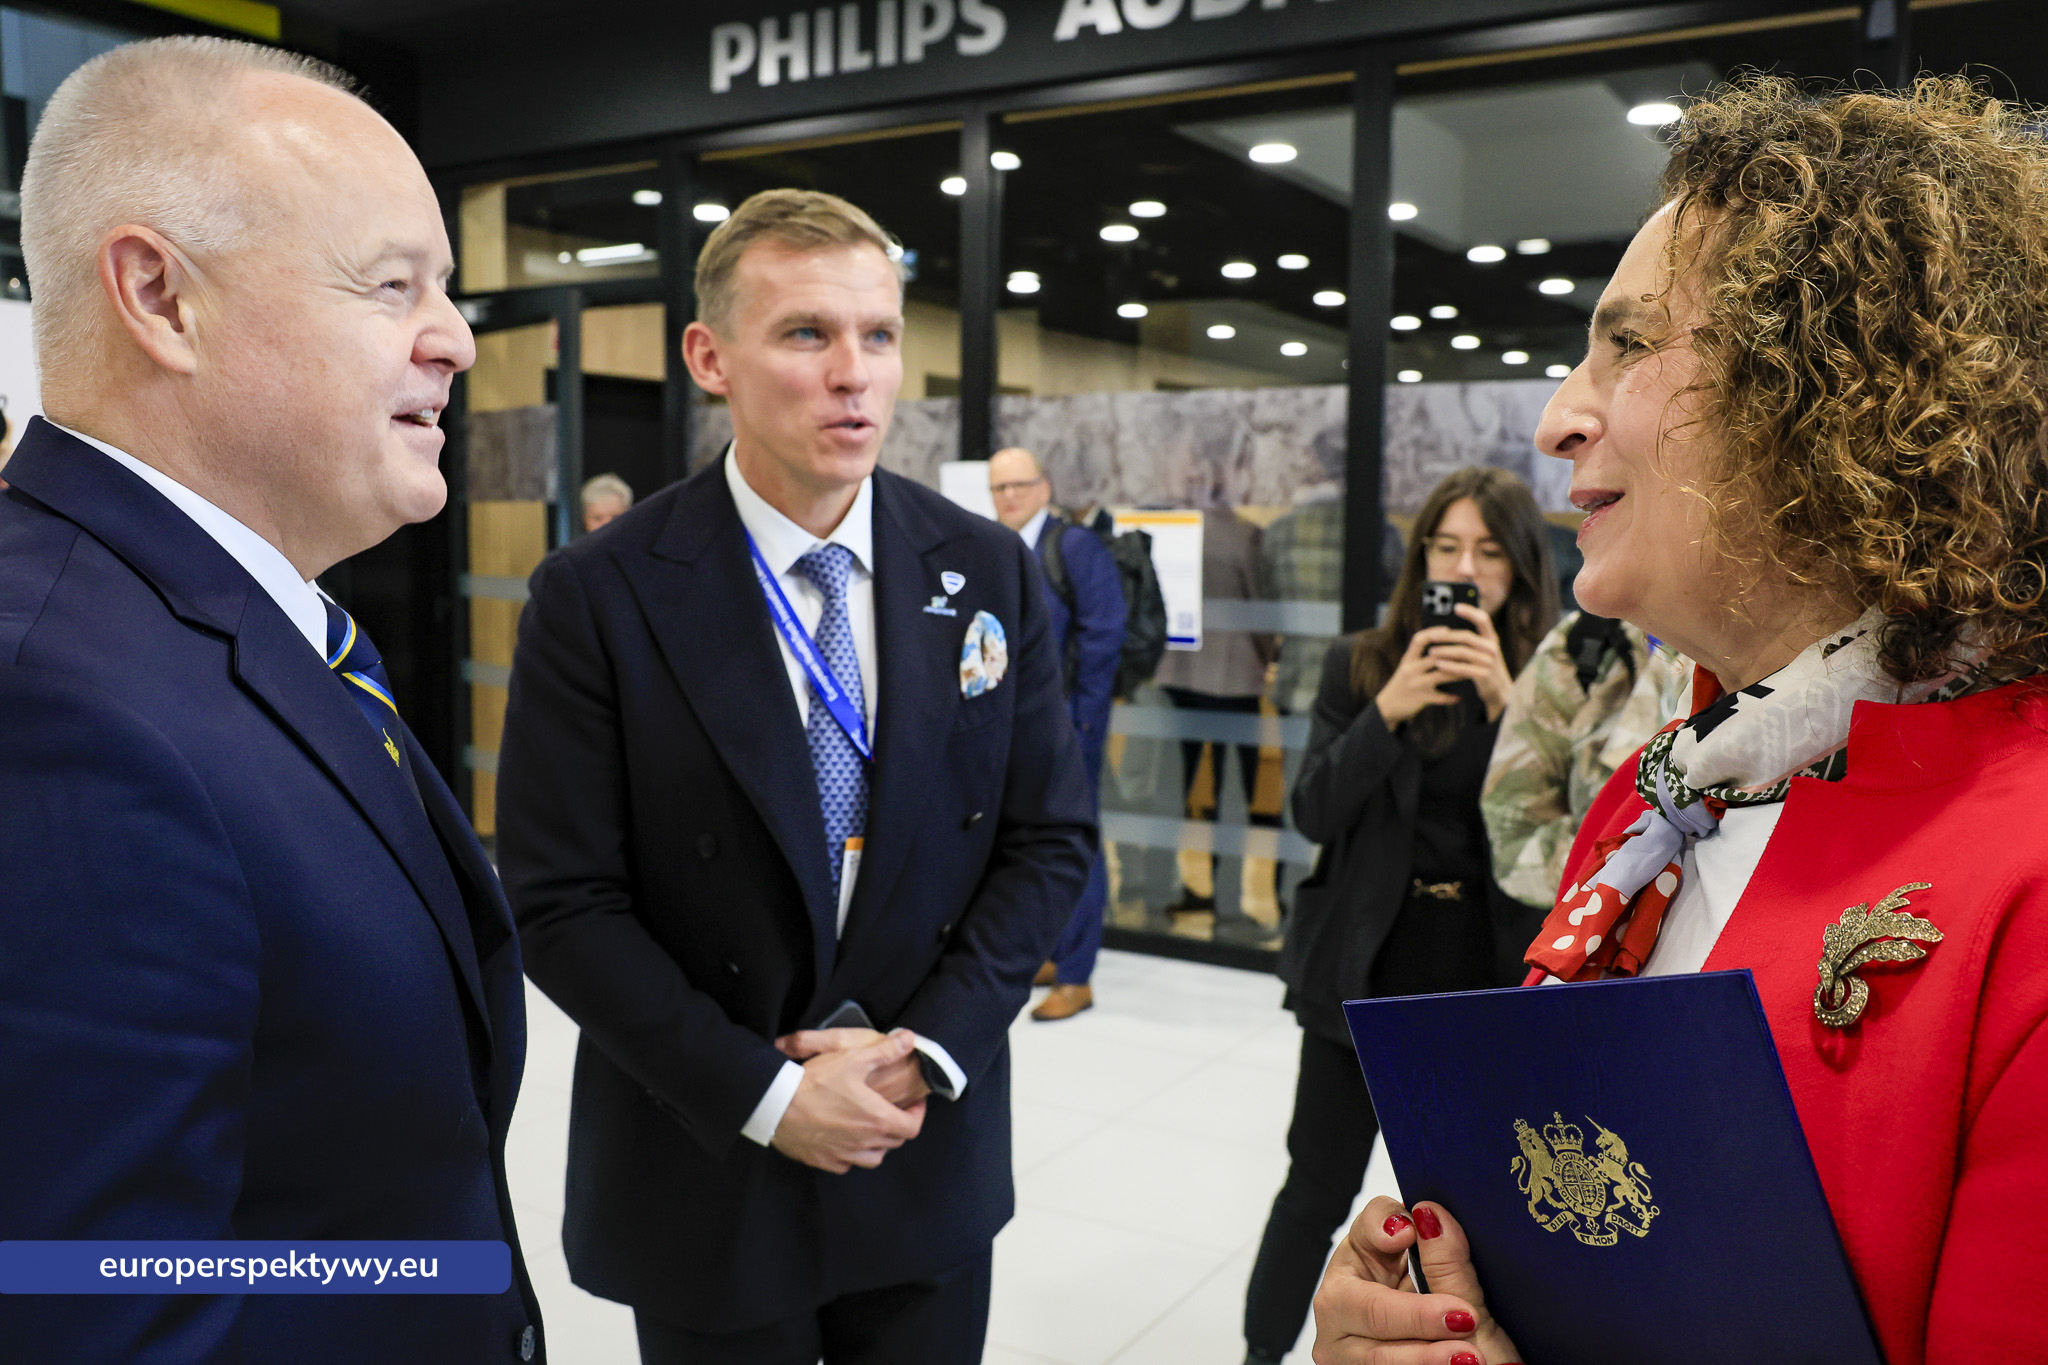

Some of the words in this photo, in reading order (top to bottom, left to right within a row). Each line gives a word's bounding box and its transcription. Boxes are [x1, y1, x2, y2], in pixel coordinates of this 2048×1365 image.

[710, 0, 1007, 93] PHILIPS
[1562, 1153, 1576, 1161] QUI
[1550, 1212, 1568, 1230] DIEU
[1580, 1233, 1591, 1243] ET
[1592, 1235, 1614, 1244] MON
[1611, 1214, 1641, 1235] DROIT
